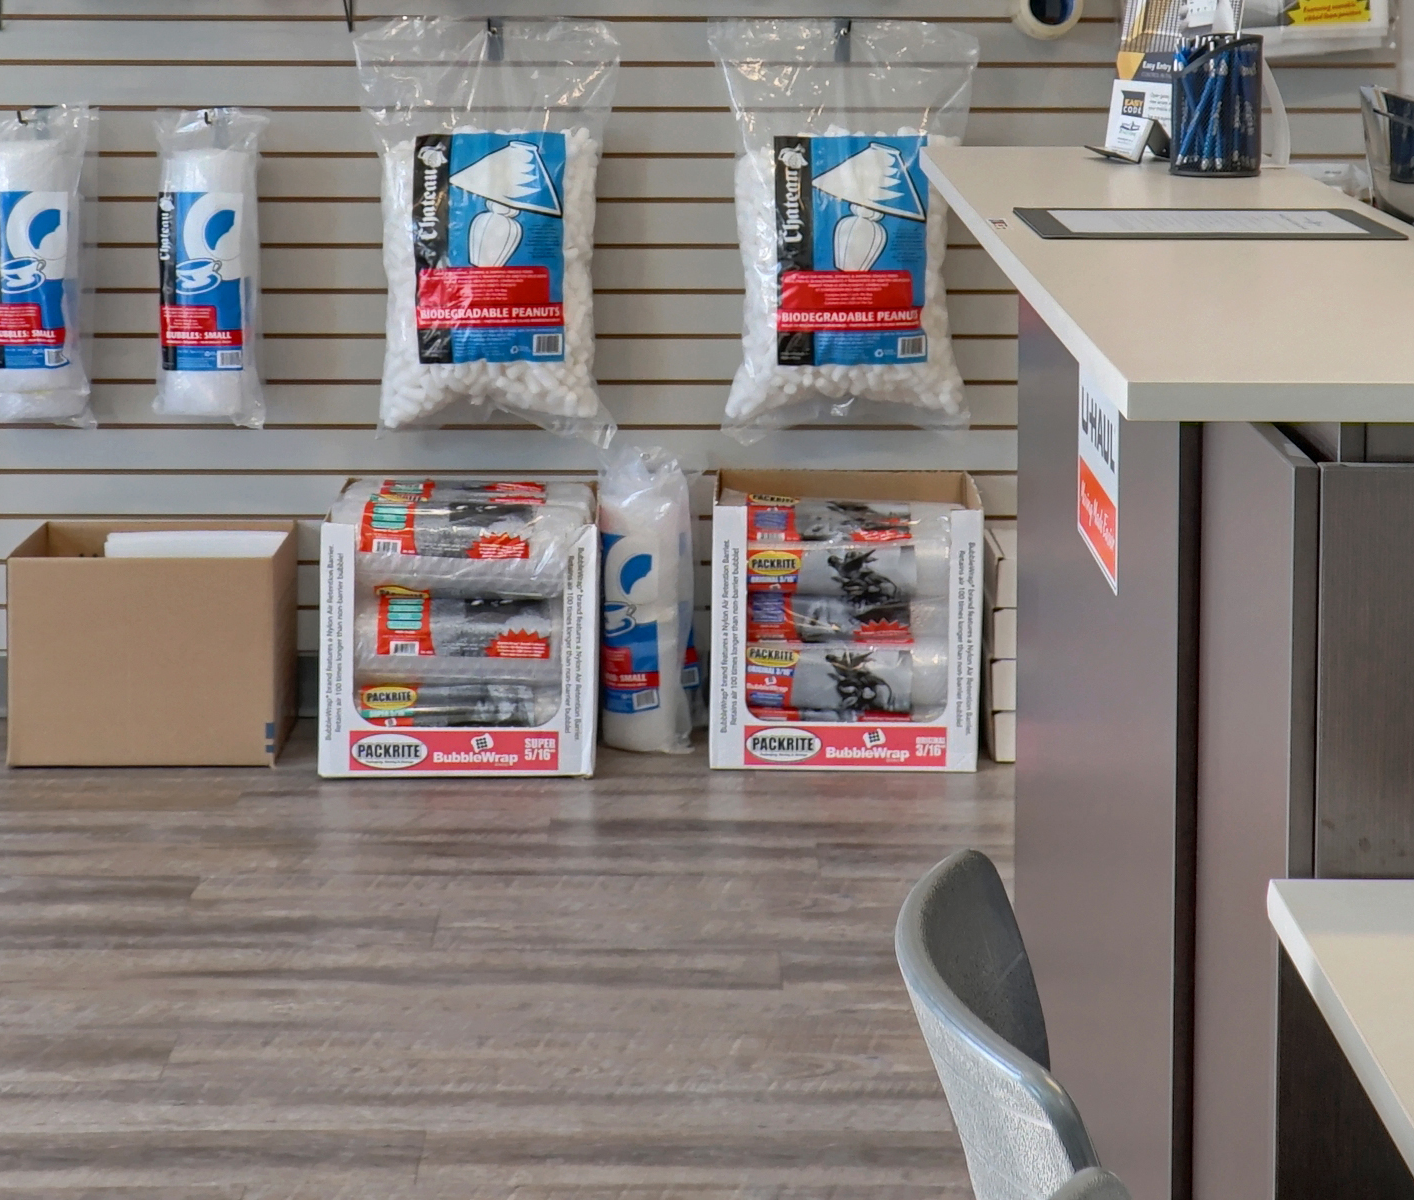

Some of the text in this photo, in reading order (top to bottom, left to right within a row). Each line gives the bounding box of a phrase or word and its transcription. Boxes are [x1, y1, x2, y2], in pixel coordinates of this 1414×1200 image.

[1142, 61, 1172, 72] Easy Entry
[418, 169, 437, 241] Chateau
[783, 169, 805, 243] Chateau
[159, 213, 174, 261] Chateau
[420, 307, 560, 319] BIODEGRADABLE PEANUTS
[781, 311, 874, 322] BIODEGRADABLE
[31, 330, 56, 338] SMALL
[204, 331, 231, 339] SMALL
[1081, 386, 1115, 474] U-HAUL
[567, 555, 575, 581] Retains
[751, 559, 796, 568] PACKRITE
[567, 582, 575, 591] air
[721, 565, 729, 599] Retention
[576, 594, 584, 614] brand
[326, 616, 334, 637] Nylon
[335, 622, 343, 637] than
[721, 610, 729, 631] Nylon
[730, 616, 738, 631] than
[565, 626, 574, 649] longer
[730, 633, 739, 656] longer
[335, 639, 344, 661] longer
[720, 637, 728, 665] features
[749, 648, 793, 661] PACKRITE
[575, 651, 583, 672] Nylon
[335, 663, 343, 682] times
[620, 674, 647, 682] SMALL
[720, 666, 728, 687] brand
[325, 673, 333, 694] brand
[335, 683, 343, 696] 100
[565, 668, 573, 707] non-barrier
[367, 692, 411, 702] PACKRITE
[729, 700, 737, 725] Retains
[357, 744, 420, 758] PACKRITE
[524, 738, 556, 748] SUPER
[752, 737, 814, 751] PACKRITE
[433, 752, 518, 765] BubbleWrap
[825, 747, 910, 761] BubbleWrap
